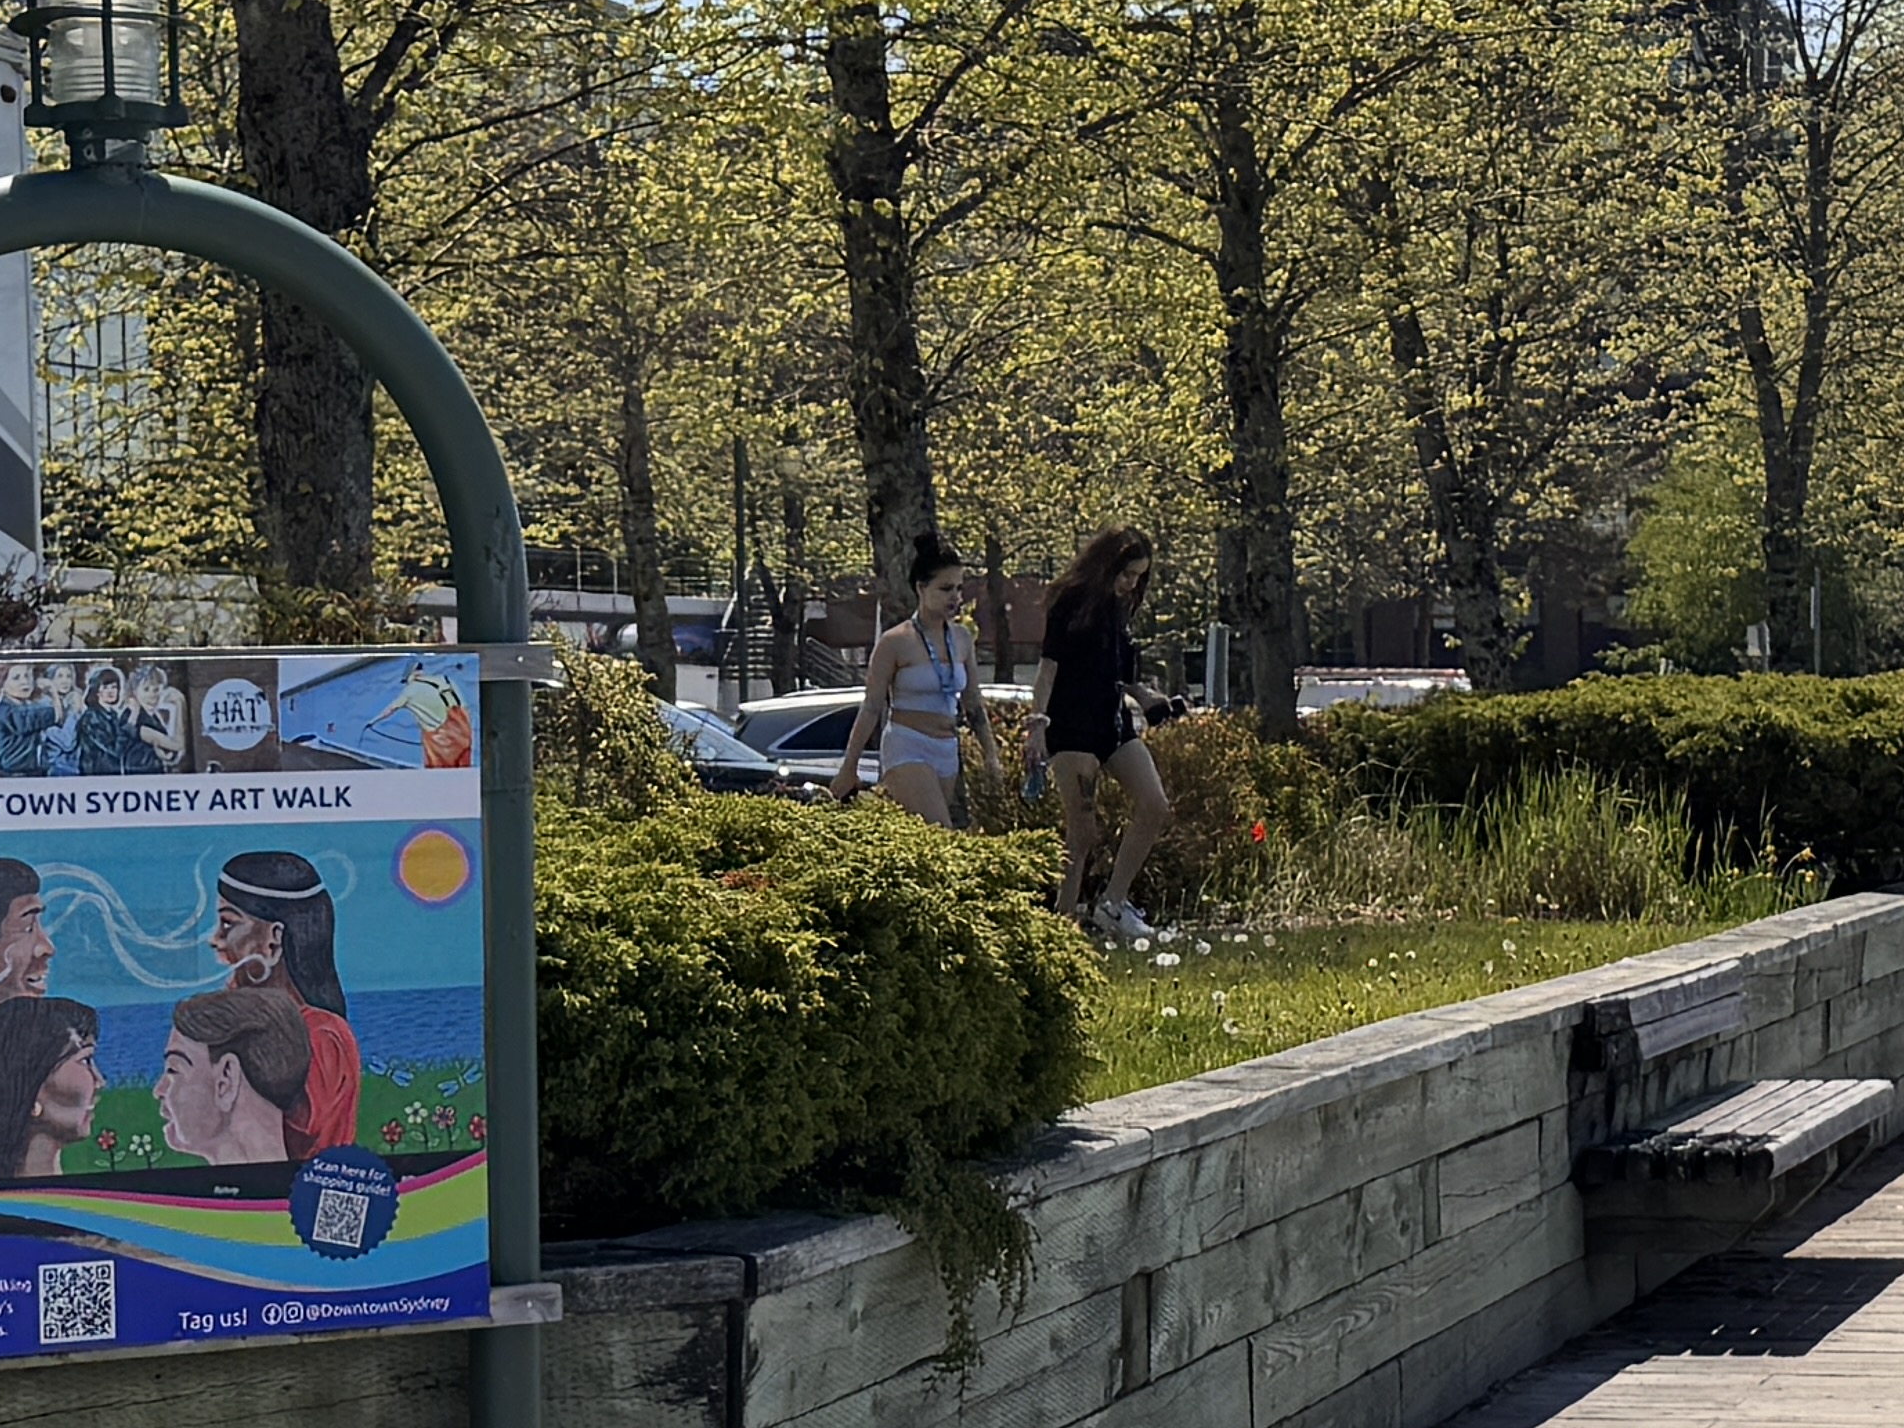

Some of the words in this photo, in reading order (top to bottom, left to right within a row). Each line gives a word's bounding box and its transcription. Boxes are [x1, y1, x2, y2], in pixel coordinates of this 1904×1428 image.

[210, 698, 258, 724] HAT
[86, 788, 200, 814] SYDNEY
[209, 787, 264, 811] ART
[272, 785, 352, 809] WALK
[312, 1158, 339, 1175] Scan
[342, 1163, 367, 1179] here
[369, 1167, 387, 1180] for
[303, 1171, 355, 1193] shopping
[356, 1180, 391, 1197] guide!
[179, 1309, 214, 1333] Tag
[220, 1307, 248, 1328] us!
[306, 1294, 450, 1322] @DowntownSydney
